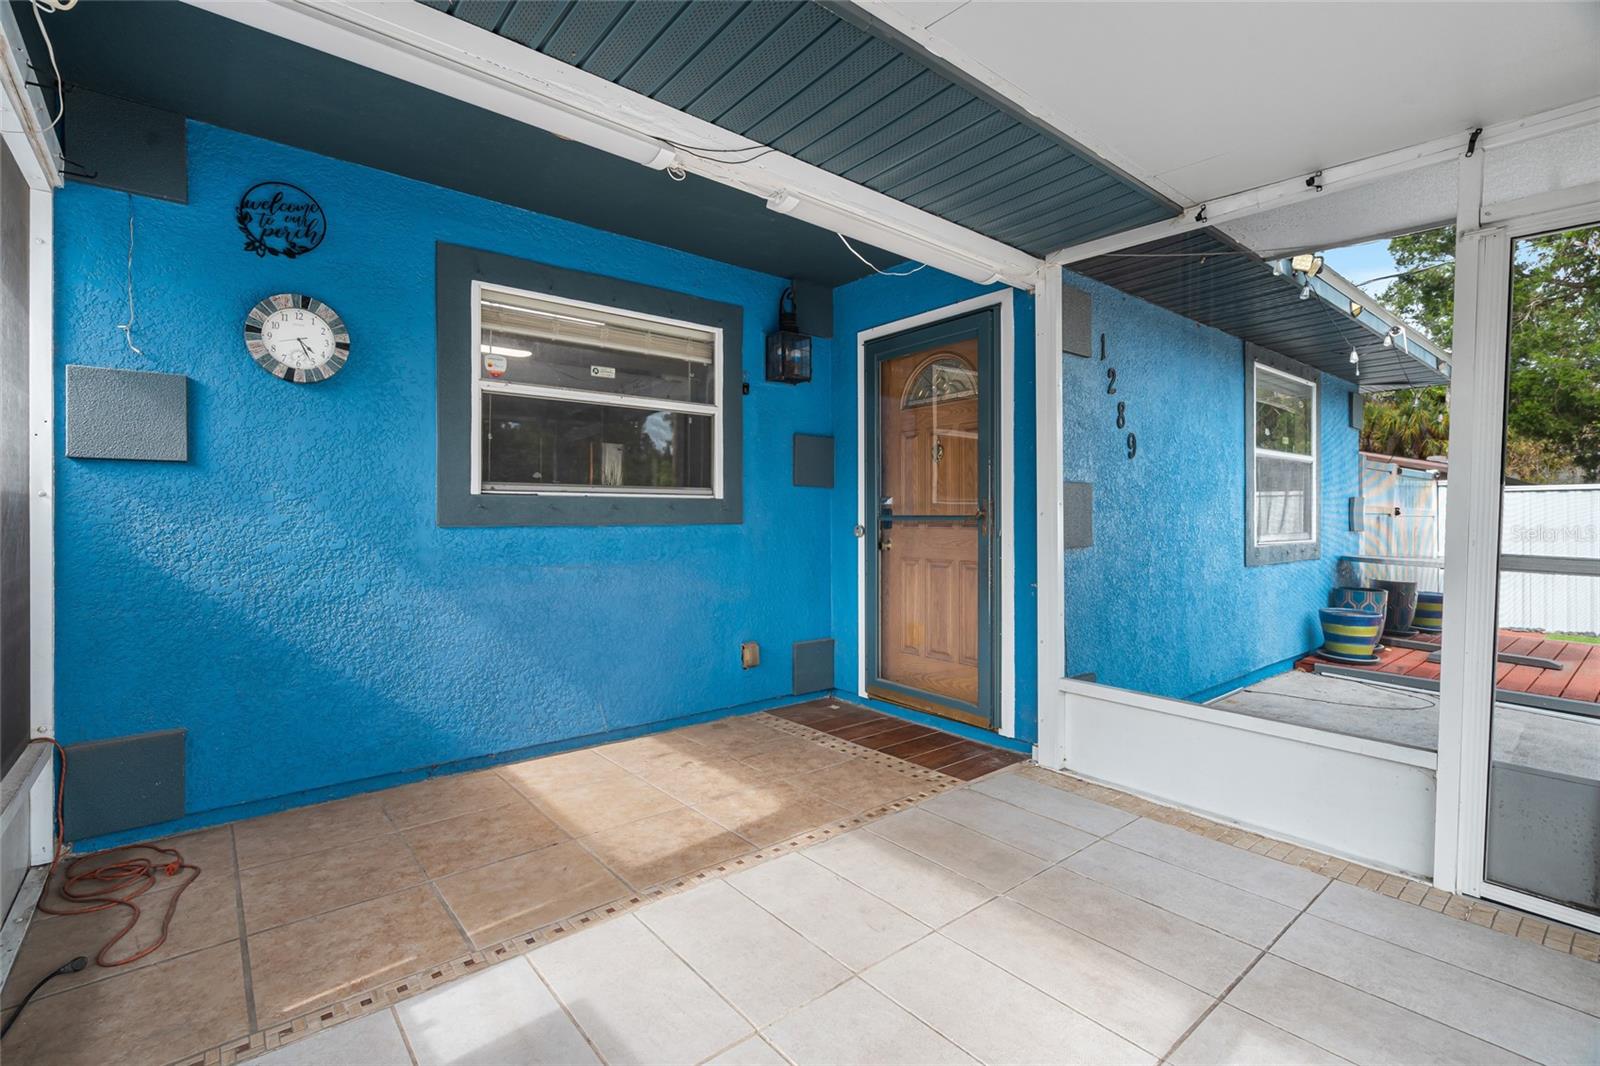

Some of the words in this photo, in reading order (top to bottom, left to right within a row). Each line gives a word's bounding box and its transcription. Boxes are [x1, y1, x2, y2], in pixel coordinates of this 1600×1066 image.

[244, 192, 318, 215] welcome
[257, 213, 274, 228] to
[260, 218, 318, 245] porch
[282, 314, 288, 322] 11
[296, 312, 304, 320] 12
